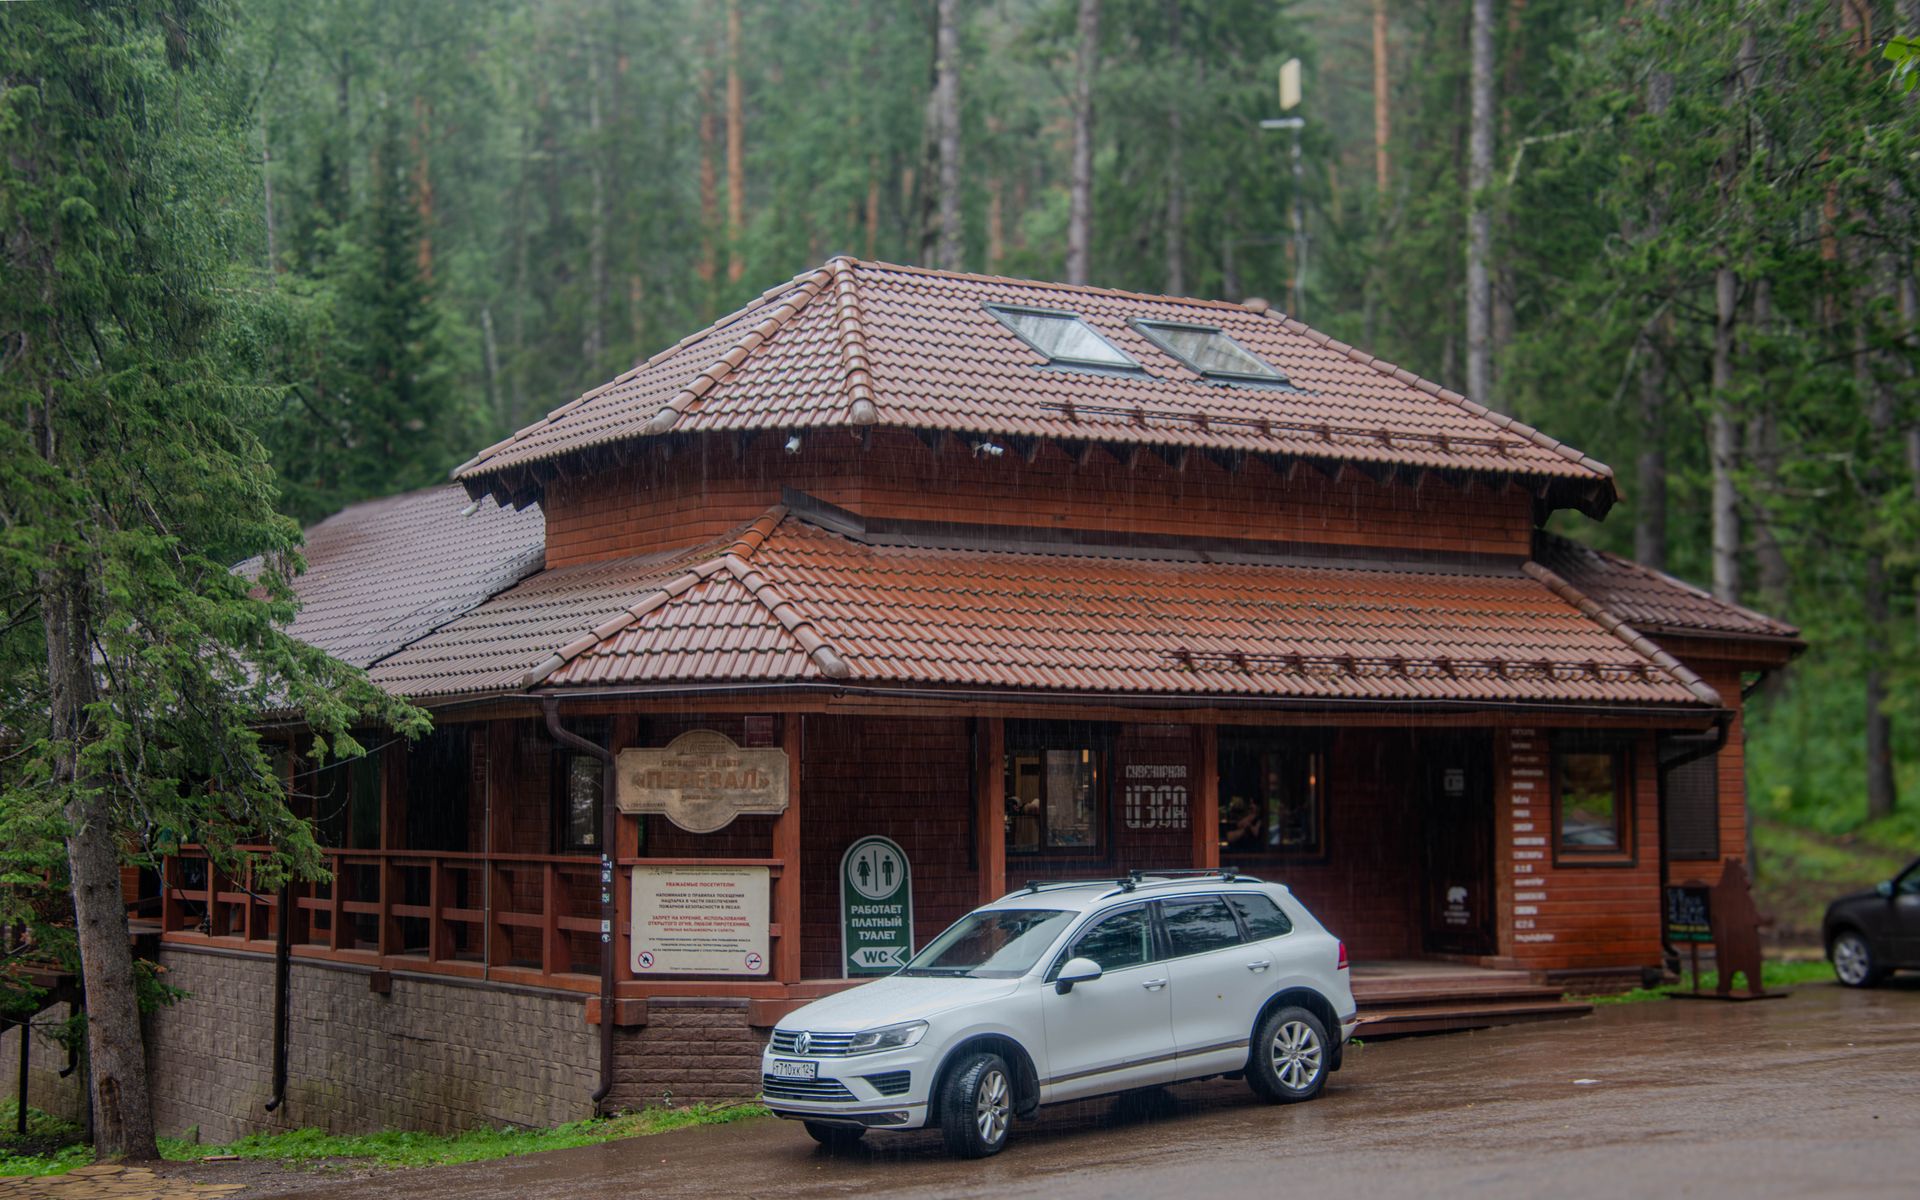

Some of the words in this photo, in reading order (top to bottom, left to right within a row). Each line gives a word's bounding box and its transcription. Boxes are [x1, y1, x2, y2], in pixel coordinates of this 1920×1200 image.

[850, 904, 903, 914] РАБОТАЕТ
[851, 915, 903, 927] ПЛАТНЫЙ
[858, 930, 896, 940] ТУАЛЕТ
[863, 950, 888, 963] WC
